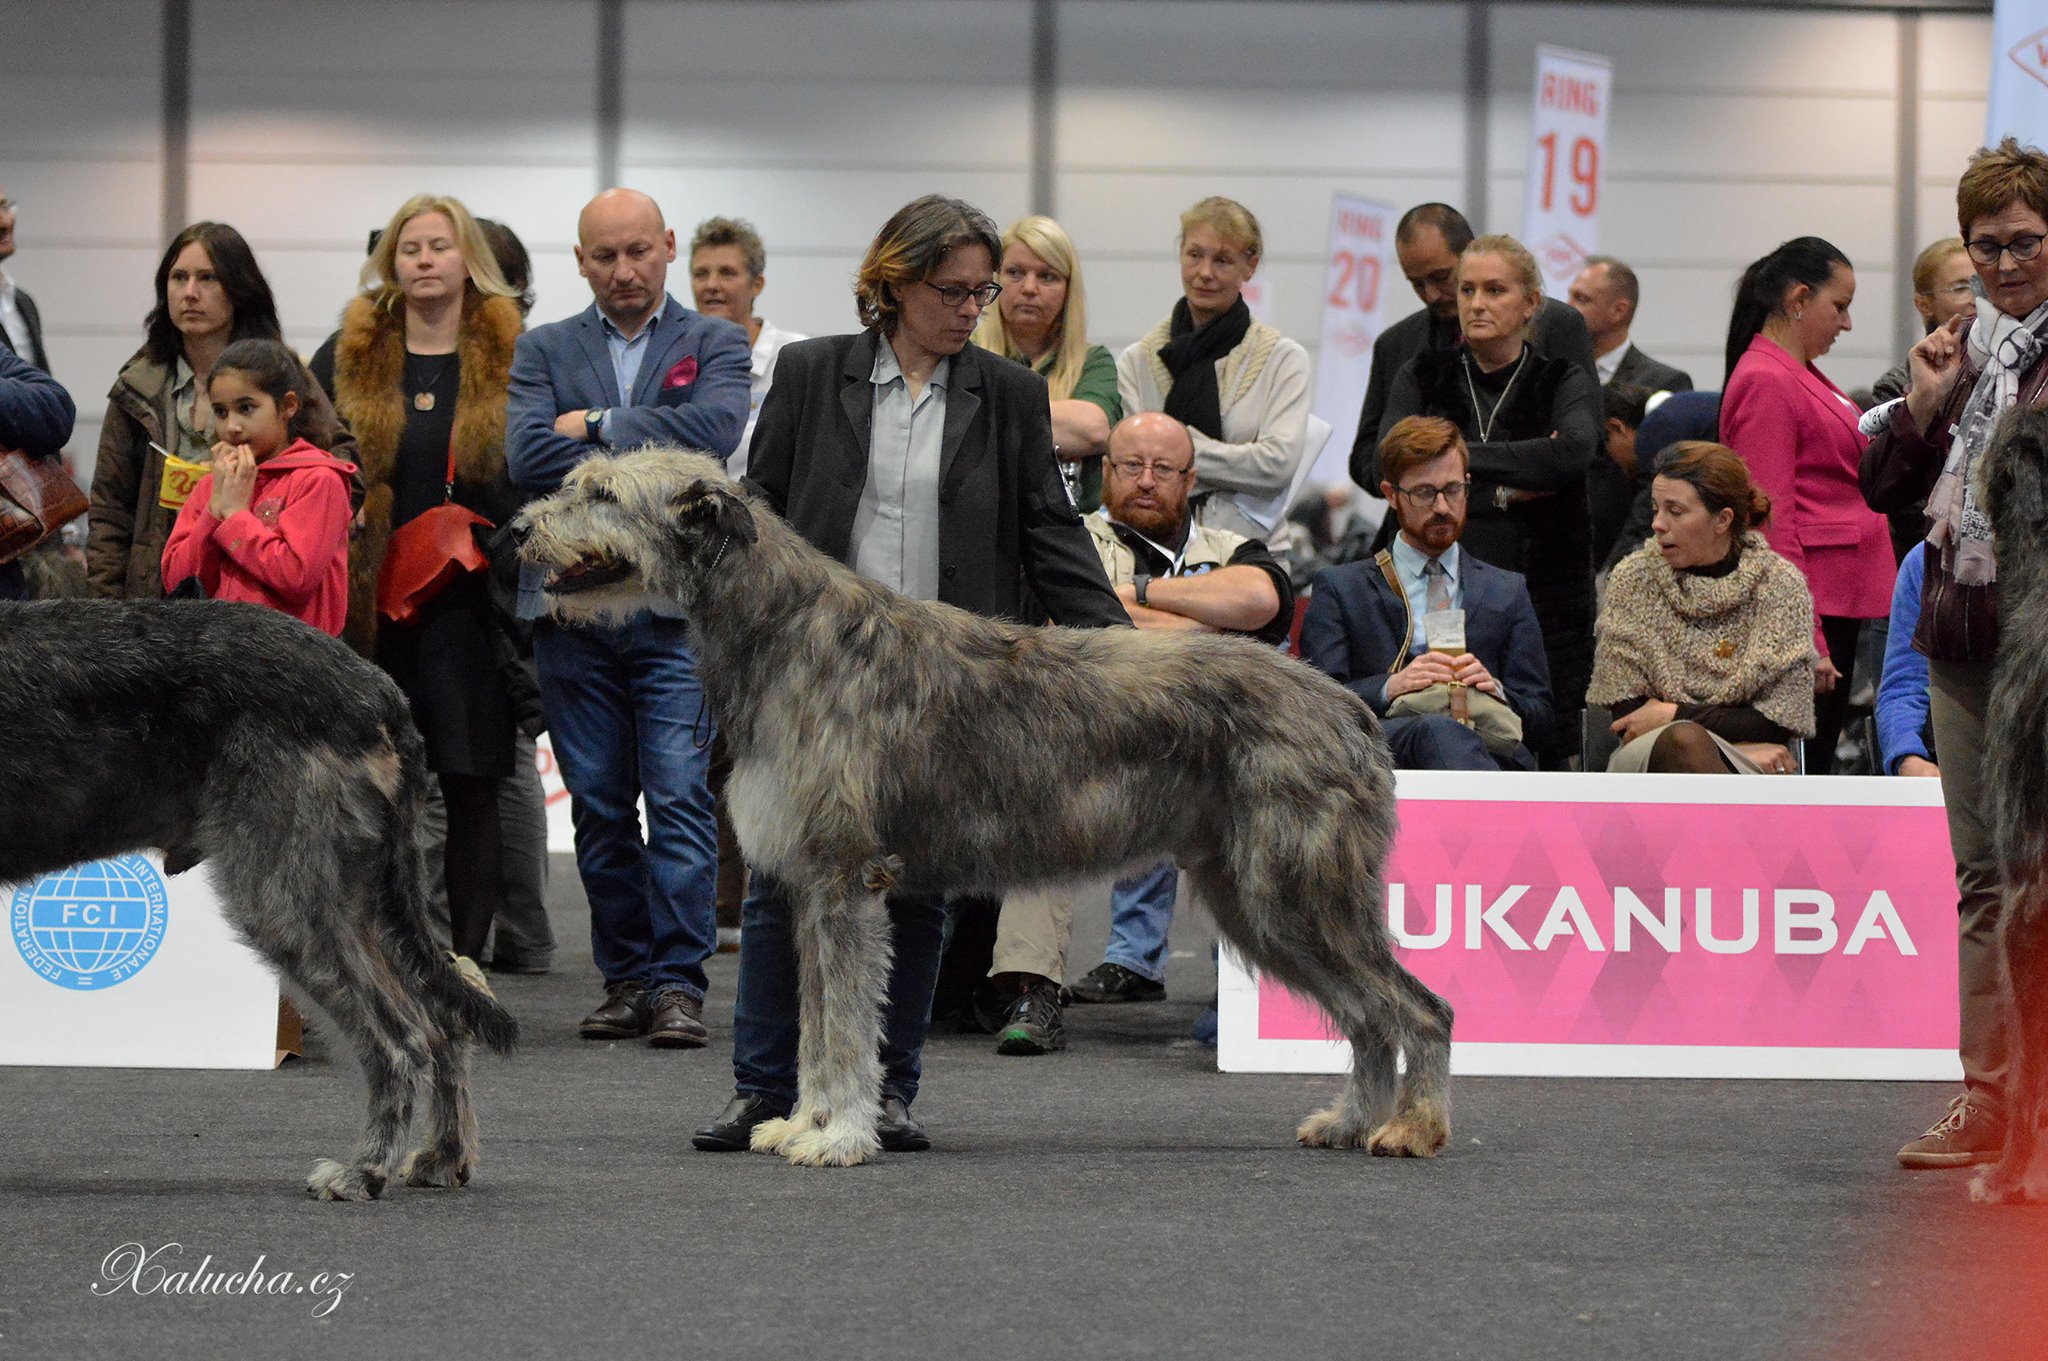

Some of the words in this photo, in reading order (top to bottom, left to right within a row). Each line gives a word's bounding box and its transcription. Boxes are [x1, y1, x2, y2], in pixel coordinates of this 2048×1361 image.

[1541, 73, 1598, 119] RING
[1537, 130, 1599, 219] 19
[1328, 250, 1384, 315] 20
[62, 903, 117, 925] FCI
[110, 859, 165, 981] INTERNATIONALE
[1388, 882, 1919, 956] UKANUBA
